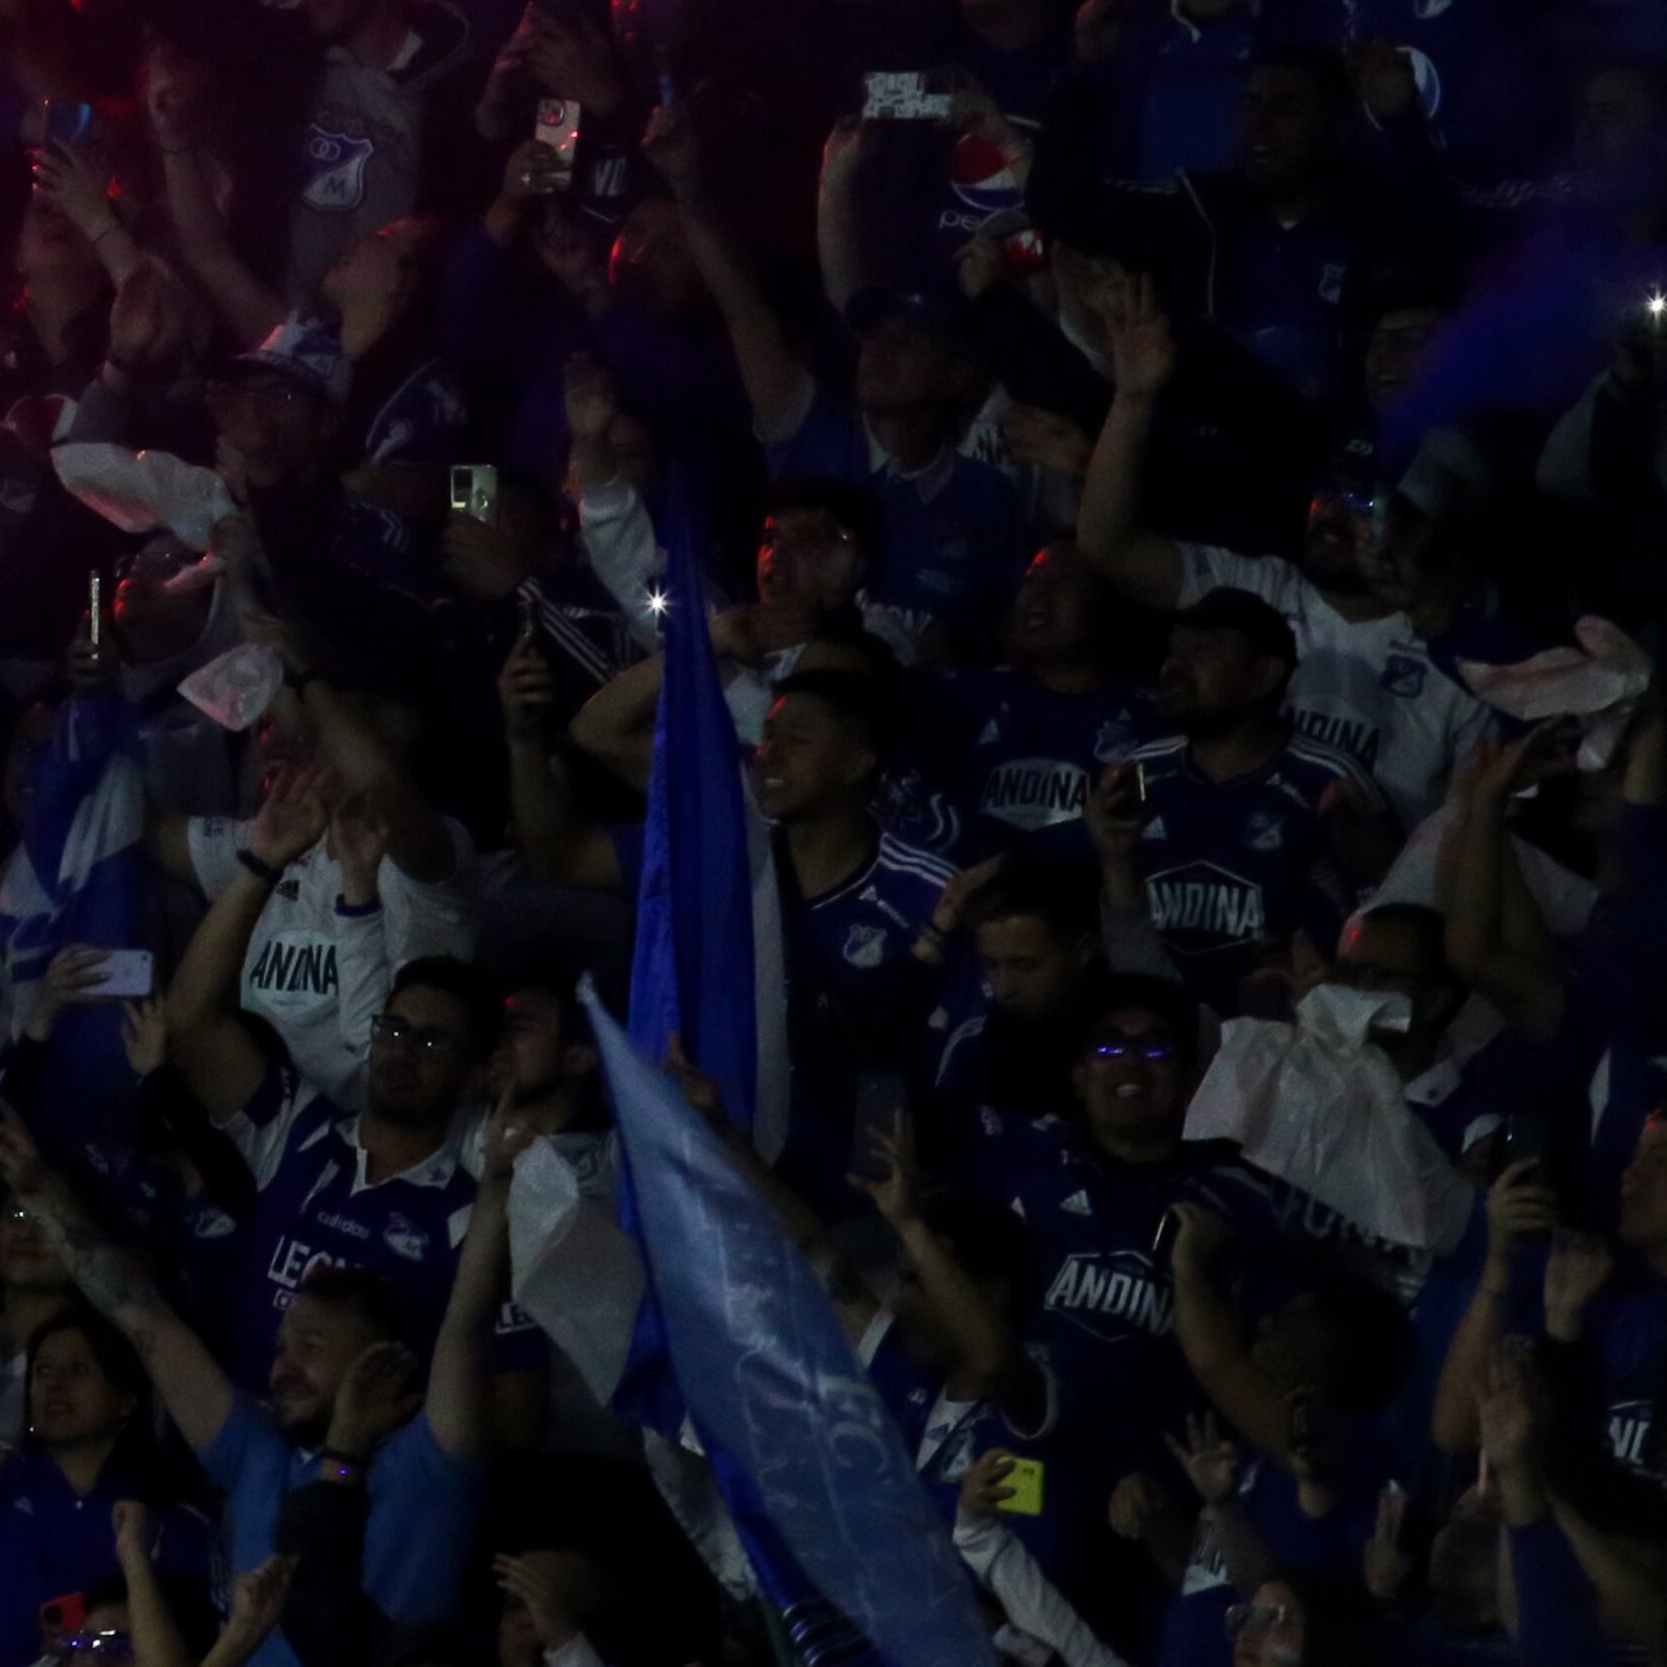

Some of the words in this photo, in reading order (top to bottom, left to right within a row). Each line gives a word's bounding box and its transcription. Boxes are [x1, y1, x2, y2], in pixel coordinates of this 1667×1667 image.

[981, 770, 1091, 814] ANDINA
[1146, 880, 1265, 940] ANDINA
[1044, 1257, 1171, 1337] ANDIN
